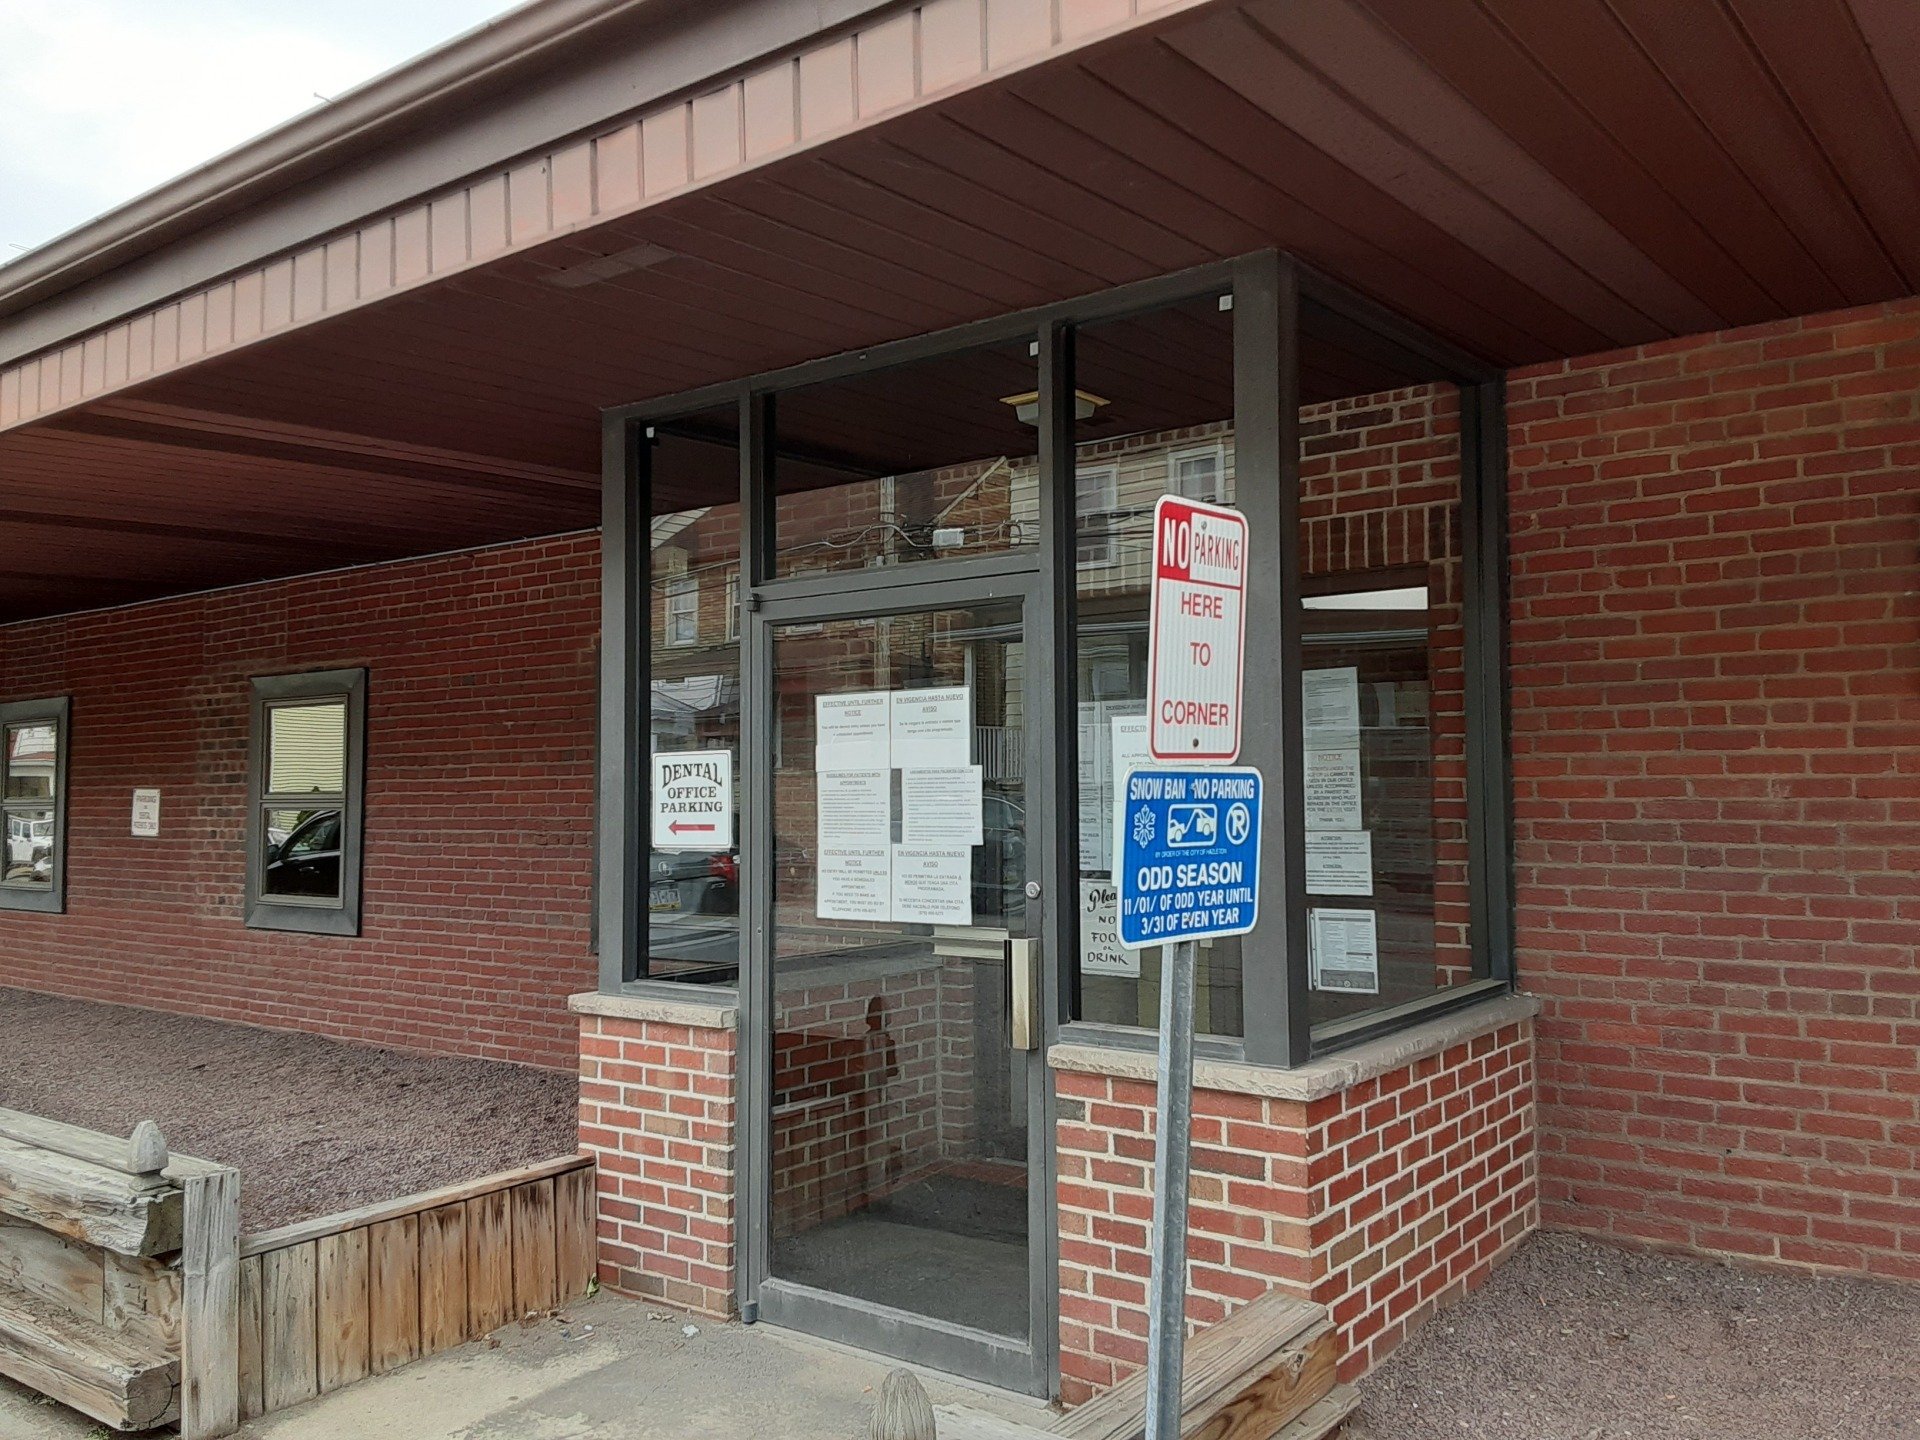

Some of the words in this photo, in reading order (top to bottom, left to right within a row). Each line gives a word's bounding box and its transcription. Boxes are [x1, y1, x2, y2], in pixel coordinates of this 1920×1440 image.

[1163, 517, 1190, 570] NO
[1194, 532, 1239, 570] PARKING
[1181, 591, 1223, 619] HERE
[1190, 642, 1211, 666] TO
[1162, 700, 1229, 726] CORNER
[1120, 725, 1147, 733] EFFECTI
[662, 762, 723, 789] DENTAL
[667, 786, 717, 799] OFFICE
[1130, 777, 1163, 800] SNOW
[1164, 778, 1186, 800] BAN
[1194, 778, 1209, 800] NO
[1211, 779, 1255, 799] PARKING
[660, 801, 723, 813] PARKING
[1137, 865, 1173, 892] ODD
[1176, 861, 1243, 888] SEASON
[1087, 889, 1117, 913] Plea
[1160, 893, 1173, 911] OF
[1174, 892, 1195, 910] ODD
[1197, 889, 1224, 907] YEAR
[1226, 887, 1253, 905] UNTIL
[1098, 915, 1116, 924] NO
[1141, 915, 1164, 935] 3/31
[1167, 913, 1180, 931] OF
[1181, 910, 1209, 929] EVEN
[1211, 907, 1240, 925] YEAR
[1091, 932, 1117, 943] FOO
[1087, 951, 1129, 965] DRINK
